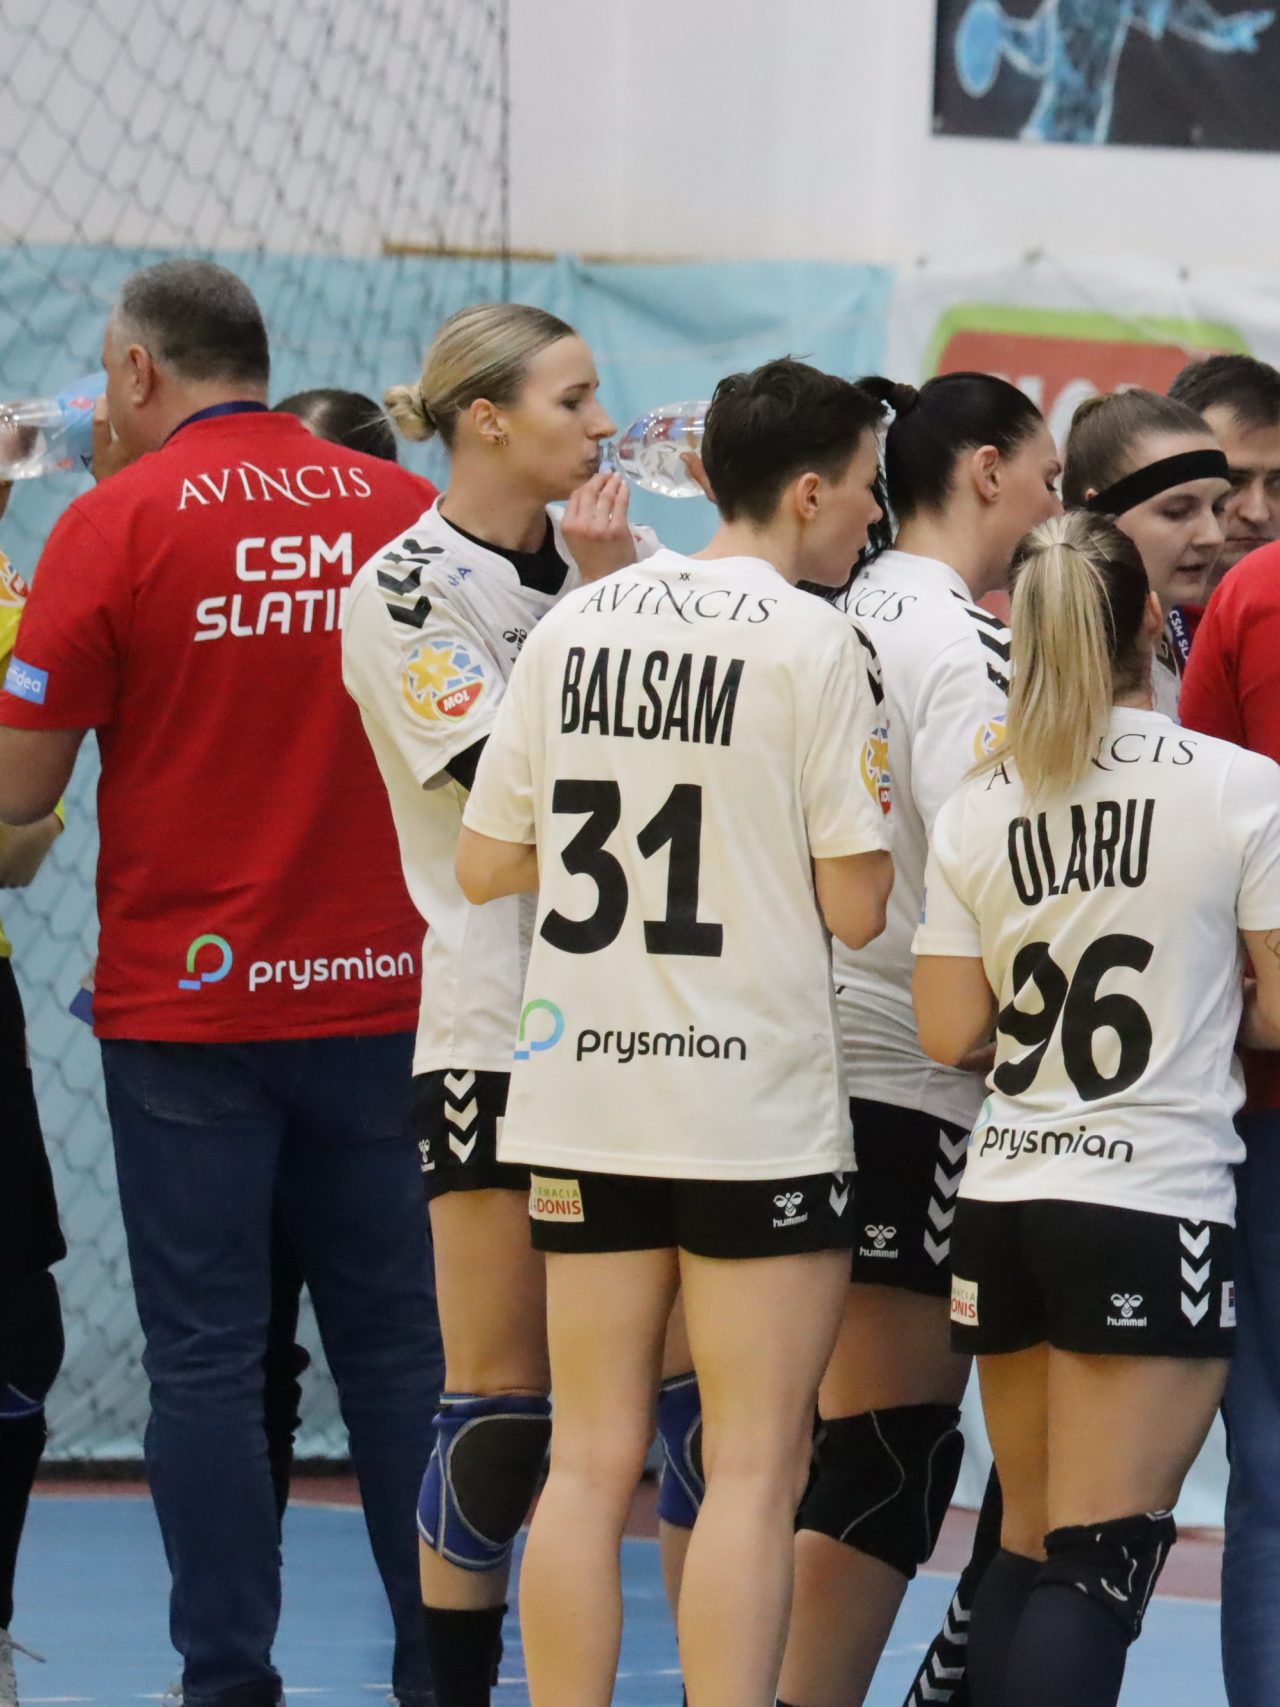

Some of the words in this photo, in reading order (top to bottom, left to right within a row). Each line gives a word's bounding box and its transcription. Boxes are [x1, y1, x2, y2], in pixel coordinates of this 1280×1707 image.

[177, 461, 371, 511] AVINCIS
[236, 531, 353, 582] CSM
[194, 586, 350, 642] SLATI
[580, 579, 778, 624] AVINCIS
[834, 587, 918, 622] NCIS
[1169, 610, 1184, 637] CSM
[443, 690, 470, 712] MOL
[561, 646, 746, 747] BALSAM
[540, 778, 724, 959] 31
[1008, 798, 1156, 906] OLARU
[249, 947, 414, 992] prysmian
[993, 933, 1155, 1102] 96
[576, 1024, 747, 1063] prysmian
[980, 1125, 1133, 1163] prysmian
[534, 1198, 582, 1215] DONIS
[773, 1212, 808, 1228] hummel
[859, 1246, 899, 1259] hummel
[951, 1297, 977, 1318] ONIS
[1107, 1315, 1147, 1327] hummel
